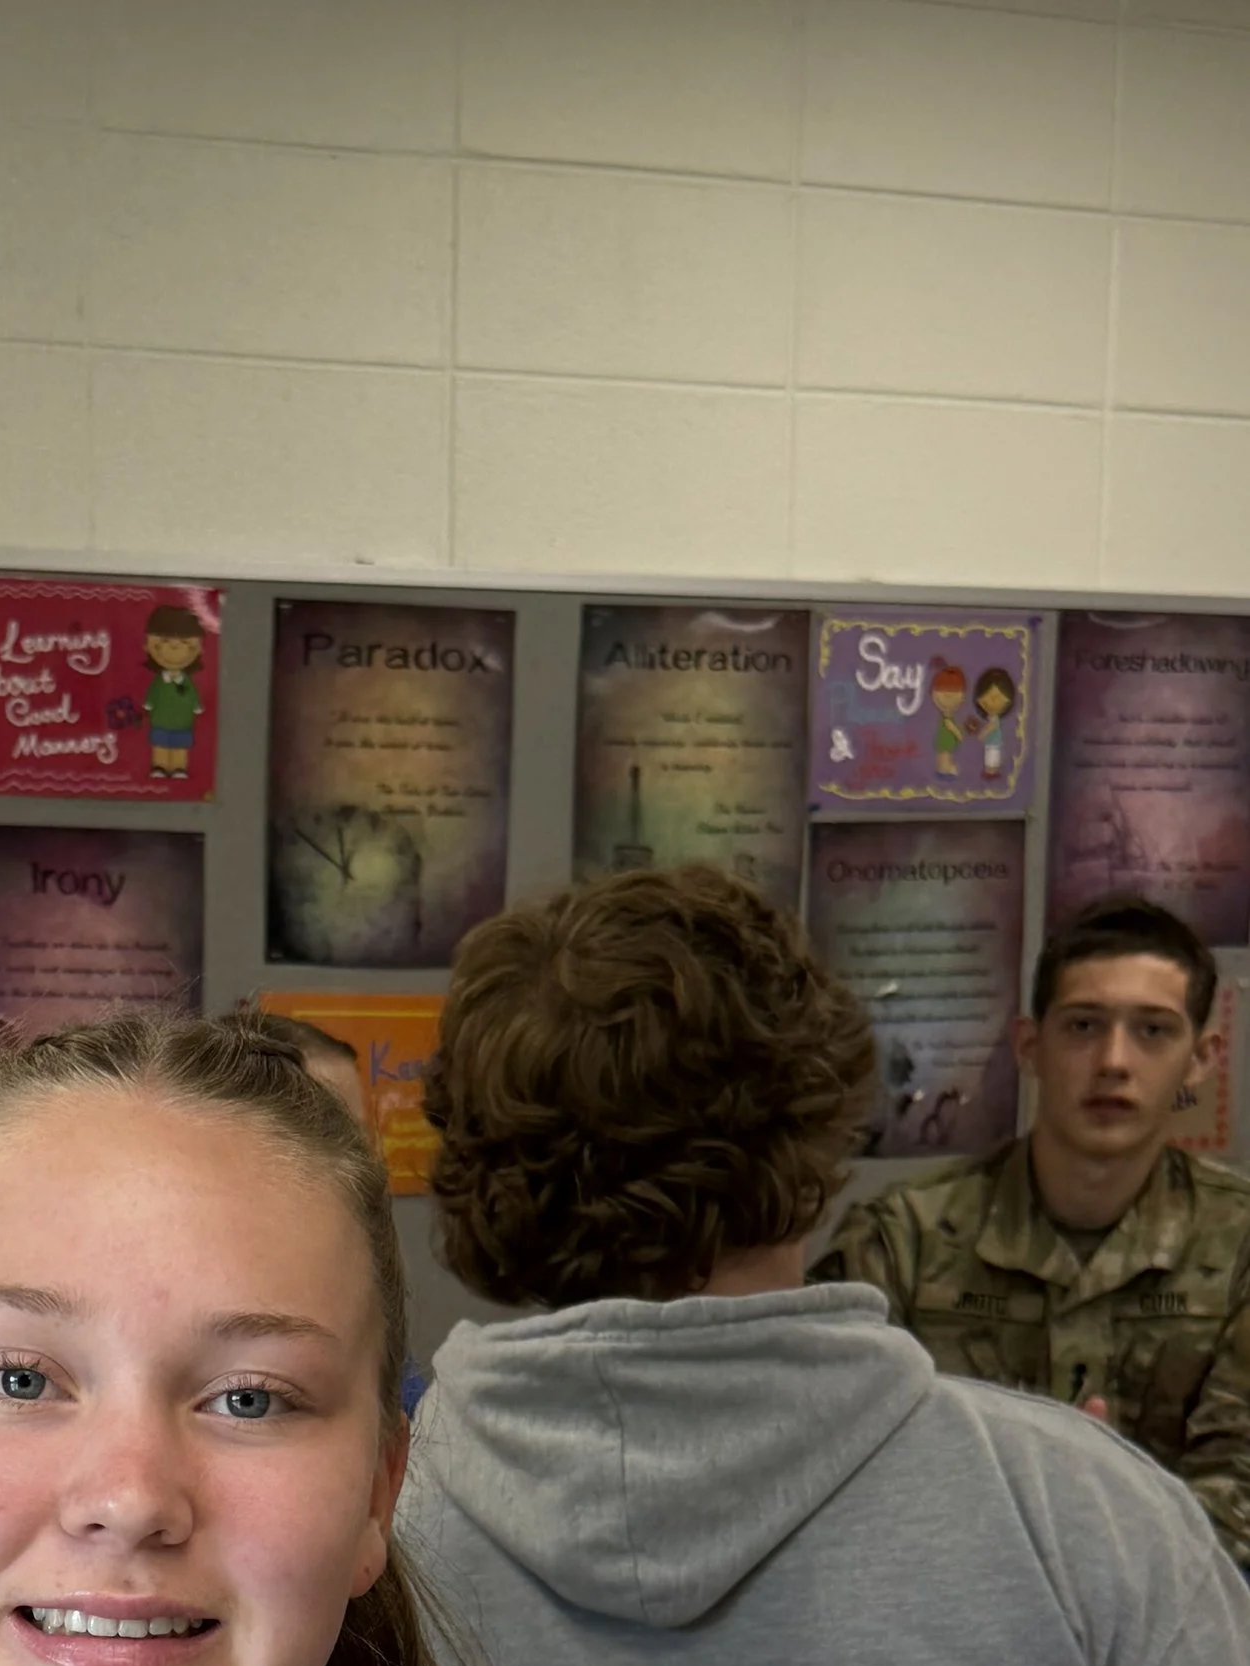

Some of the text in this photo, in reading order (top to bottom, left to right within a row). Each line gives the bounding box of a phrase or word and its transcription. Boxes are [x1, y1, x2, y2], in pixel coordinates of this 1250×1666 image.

[302, 632, 494, 674] Paradox
[605, 641, 793, 673] Alliteration
[855, 634, 924, 715] Say
[5, 698, 80, 728] Good
[29, 860, 126, 907] Irony
